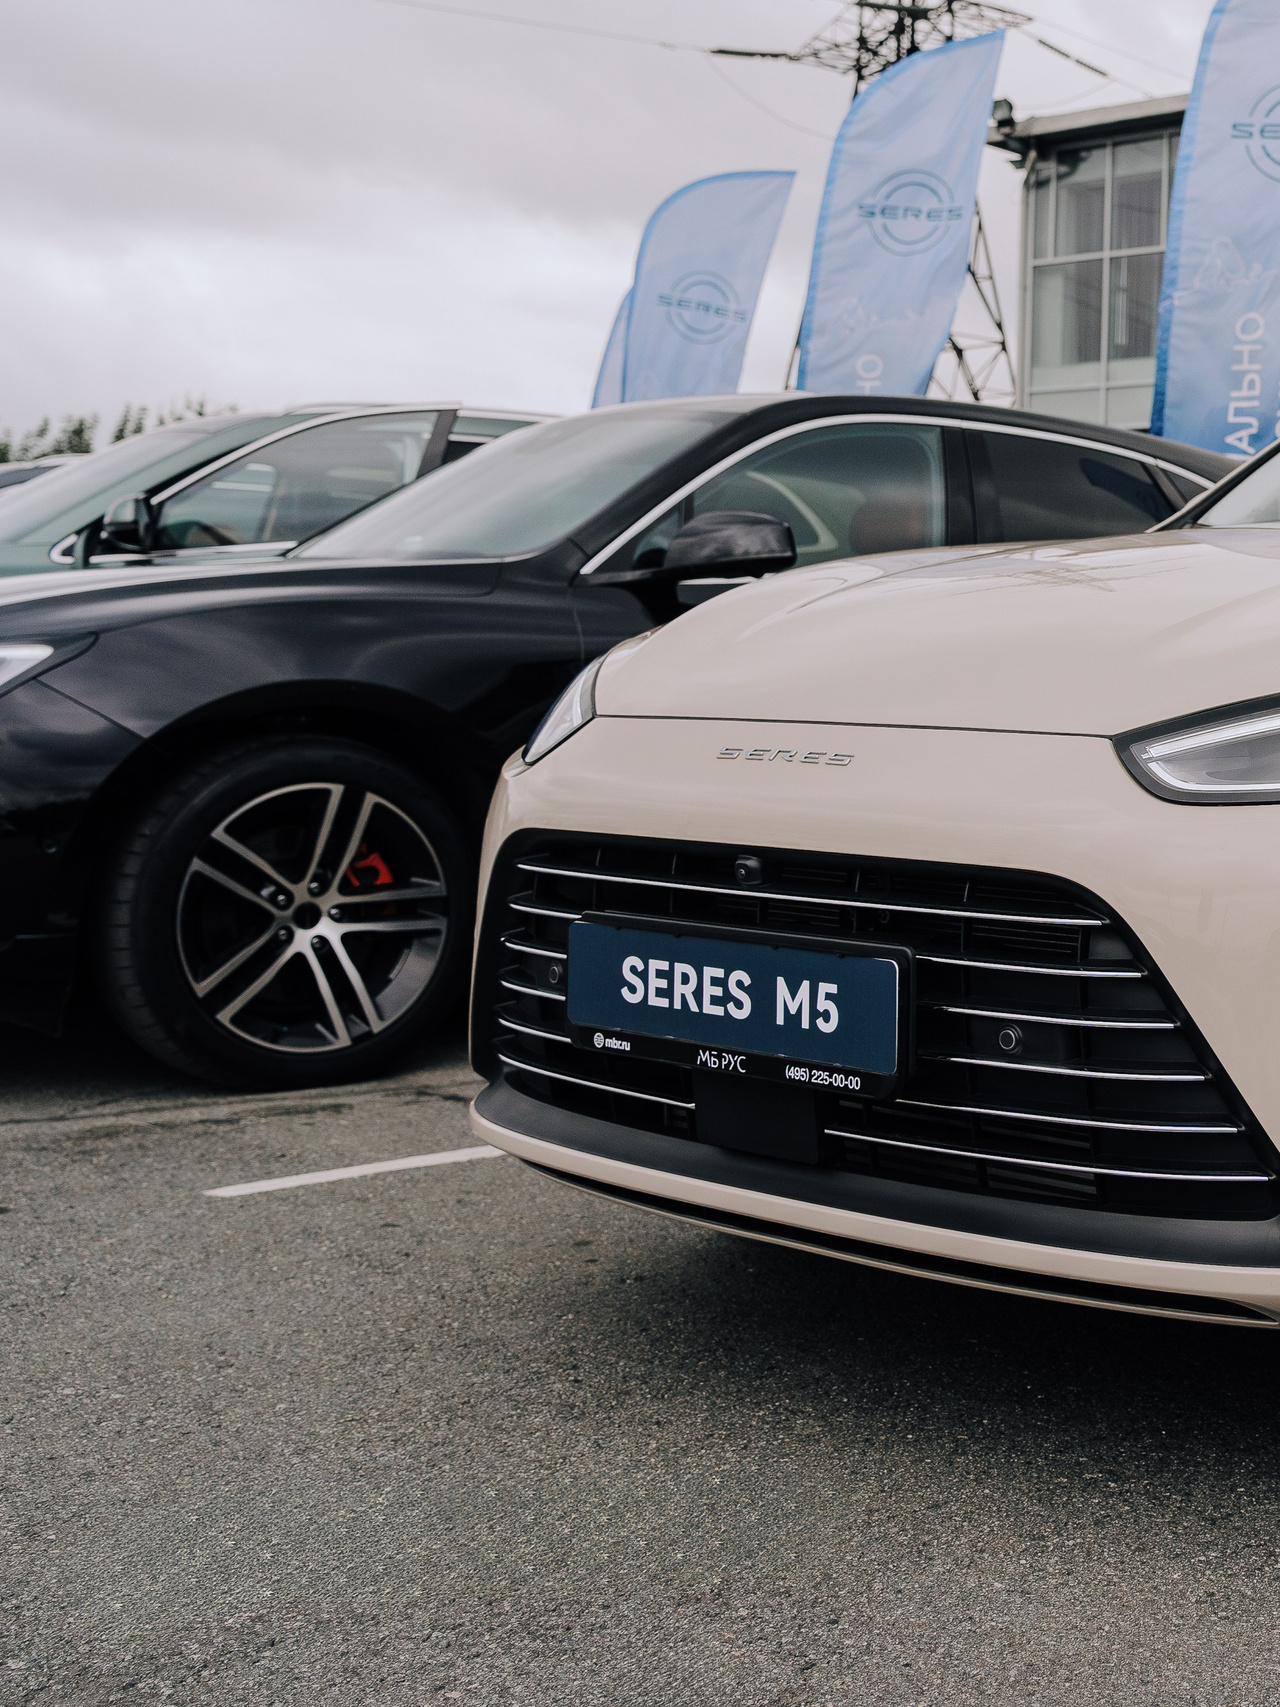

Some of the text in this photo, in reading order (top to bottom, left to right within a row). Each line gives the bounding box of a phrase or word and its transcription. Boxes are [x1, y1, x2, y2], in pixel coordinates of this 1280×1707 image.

[857, 201, 964, 223] SERES
[1224, 311, 1266, 460] АЛЬНО
[716, 747, 855, 766] SERES
[620, 955, 839, 1034] SERES M5
[604, 1037, 631, 1051] mbr.ru
[697, 1049, 746, 1073] МБ РУС
[785, 1064, 861, 1090] (495) 225-00-00
